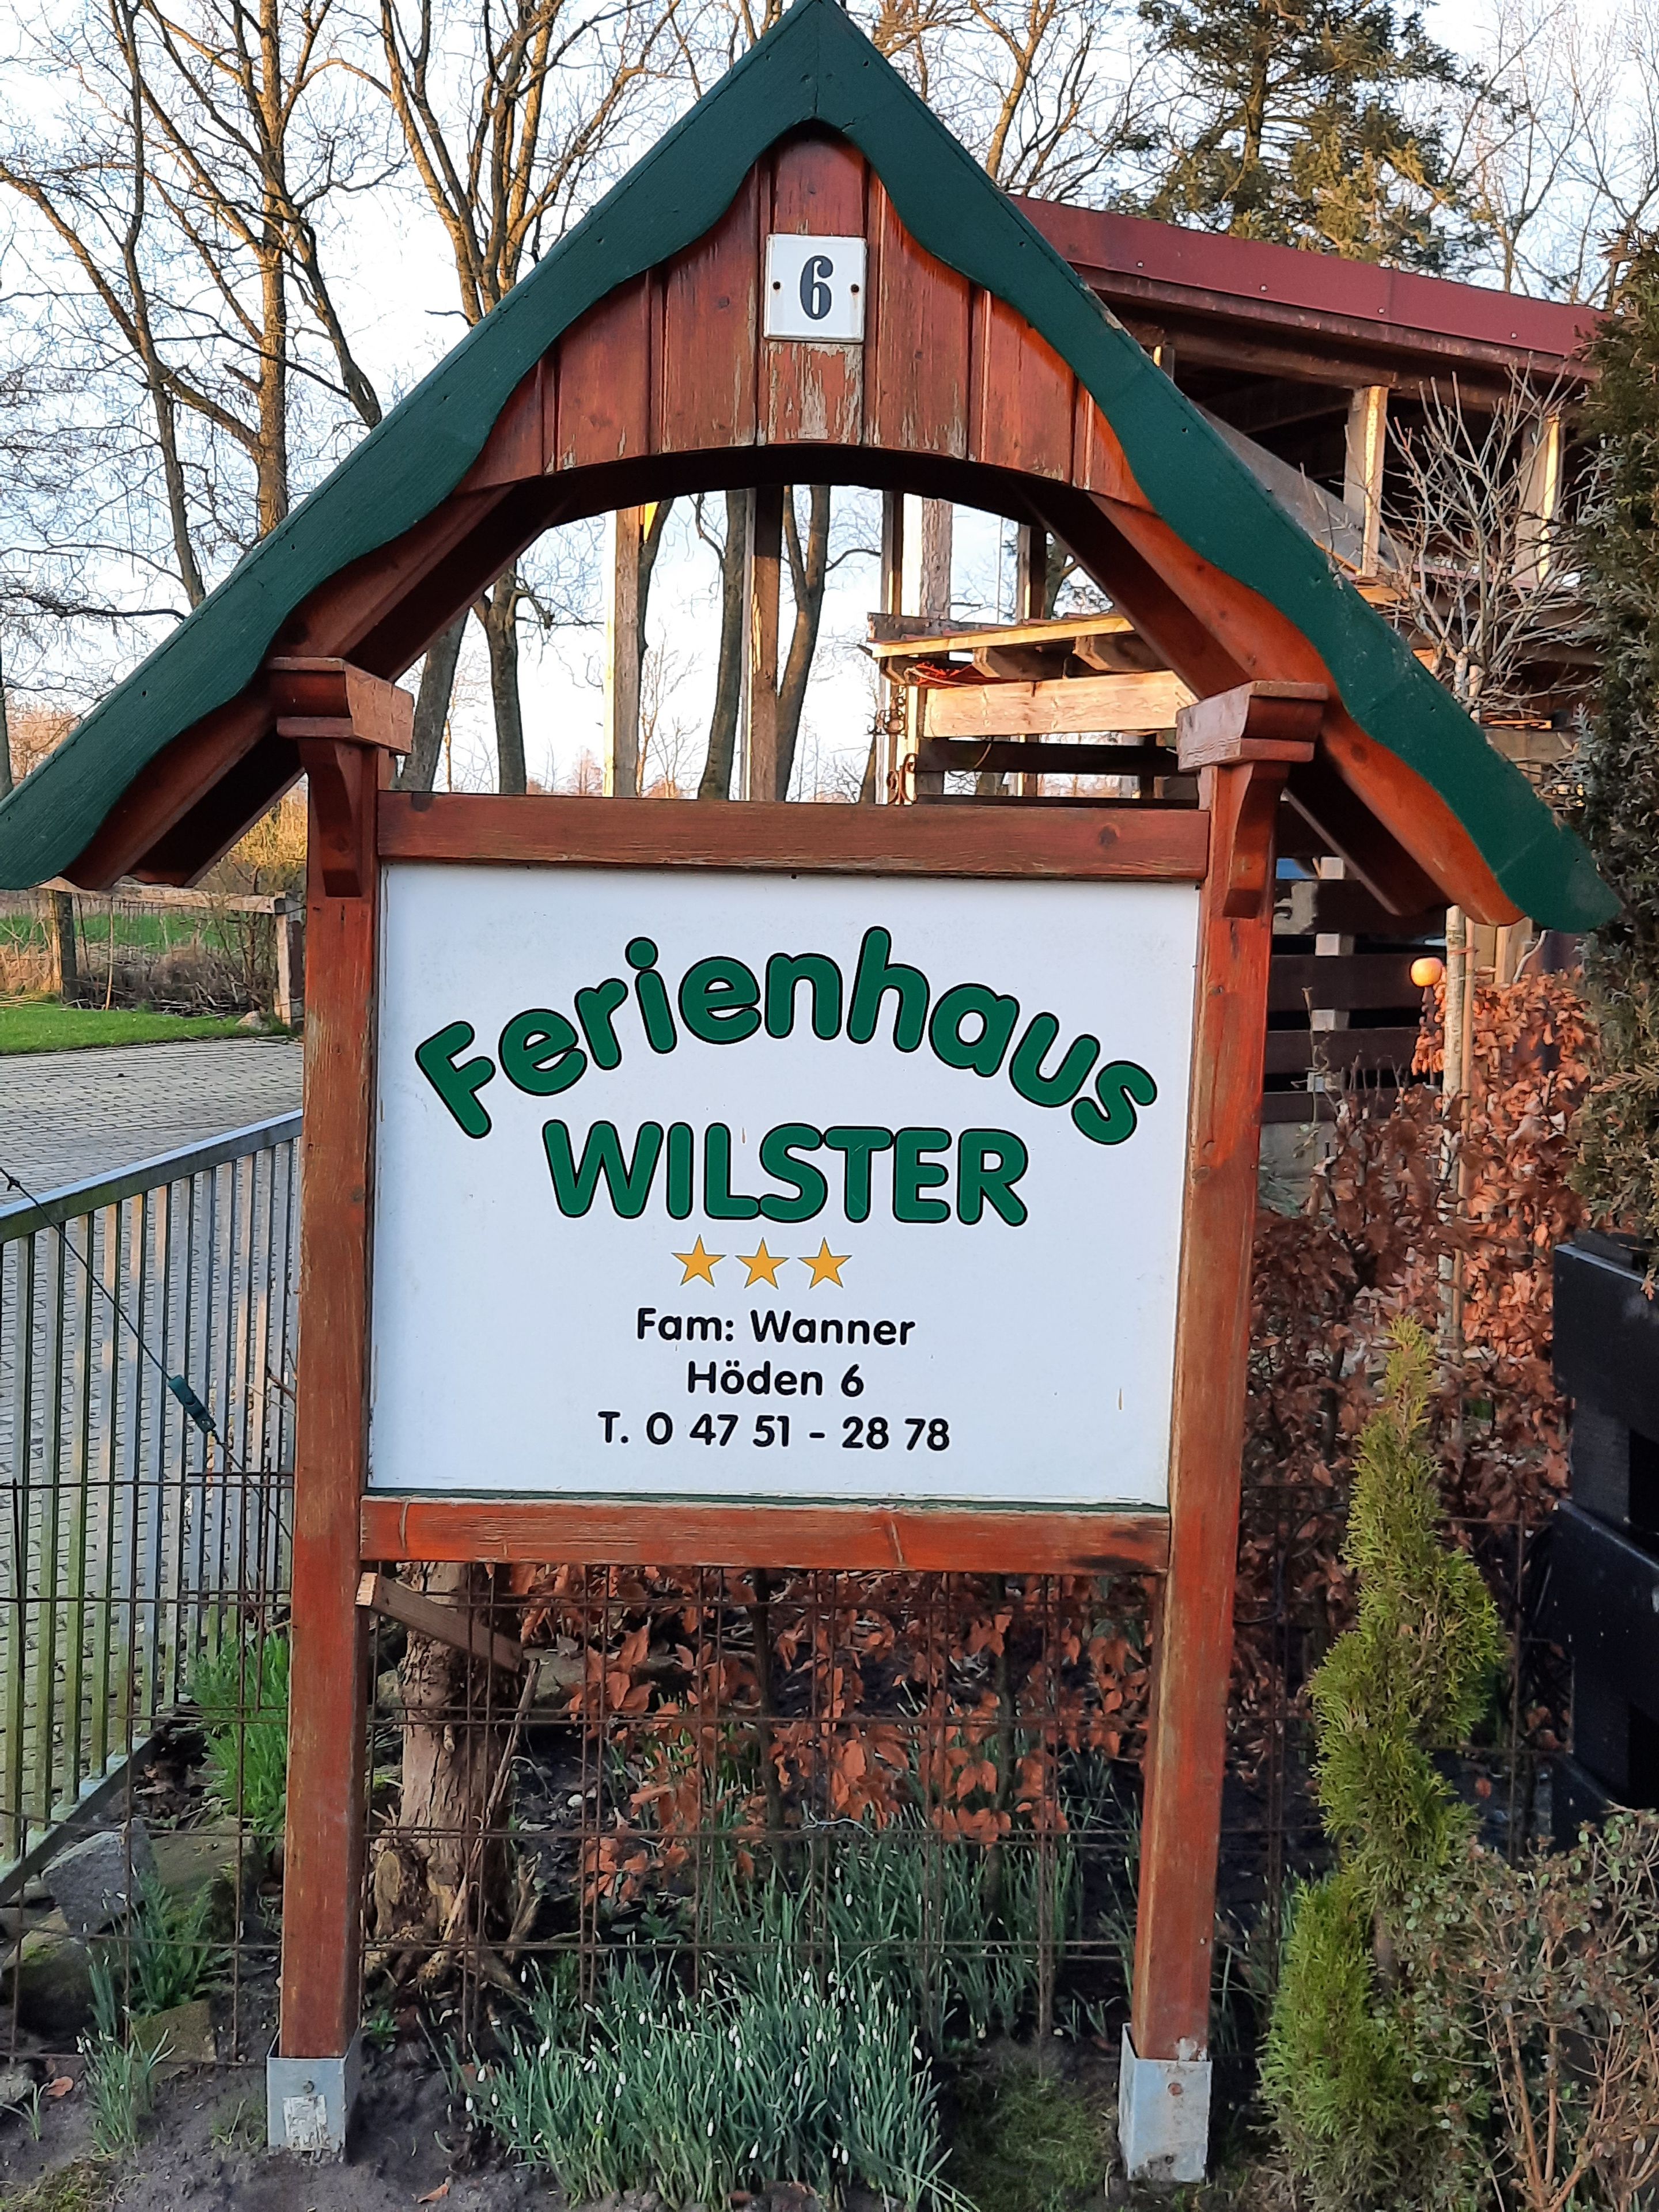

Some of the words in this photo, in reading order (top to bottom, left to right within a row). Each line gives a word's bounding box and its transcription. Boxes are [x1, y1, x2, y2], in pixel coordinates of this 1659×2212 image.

[800, 255, 834, 320] 6
[414, 926, 1158, 1146] Ferienhaus
[541, 1119, 1029, 1227] WILSTER
[637, 1308, 734, 1342] Fam:
[750, 1309, 916, 1346] Wanner
[687, 1359, 823, 1396] Höden
[840, 1363, 864, 1397] 6
[597, 1411, 628, 1444] T.
[646, 1411, 673, 1445] 0
[689, 1413, 739, 1446] 47
[752, 1415, 789, 1448] 51
[842, 1416, 889, 1450] 28
[904, 1418, 950, 1451] 78
